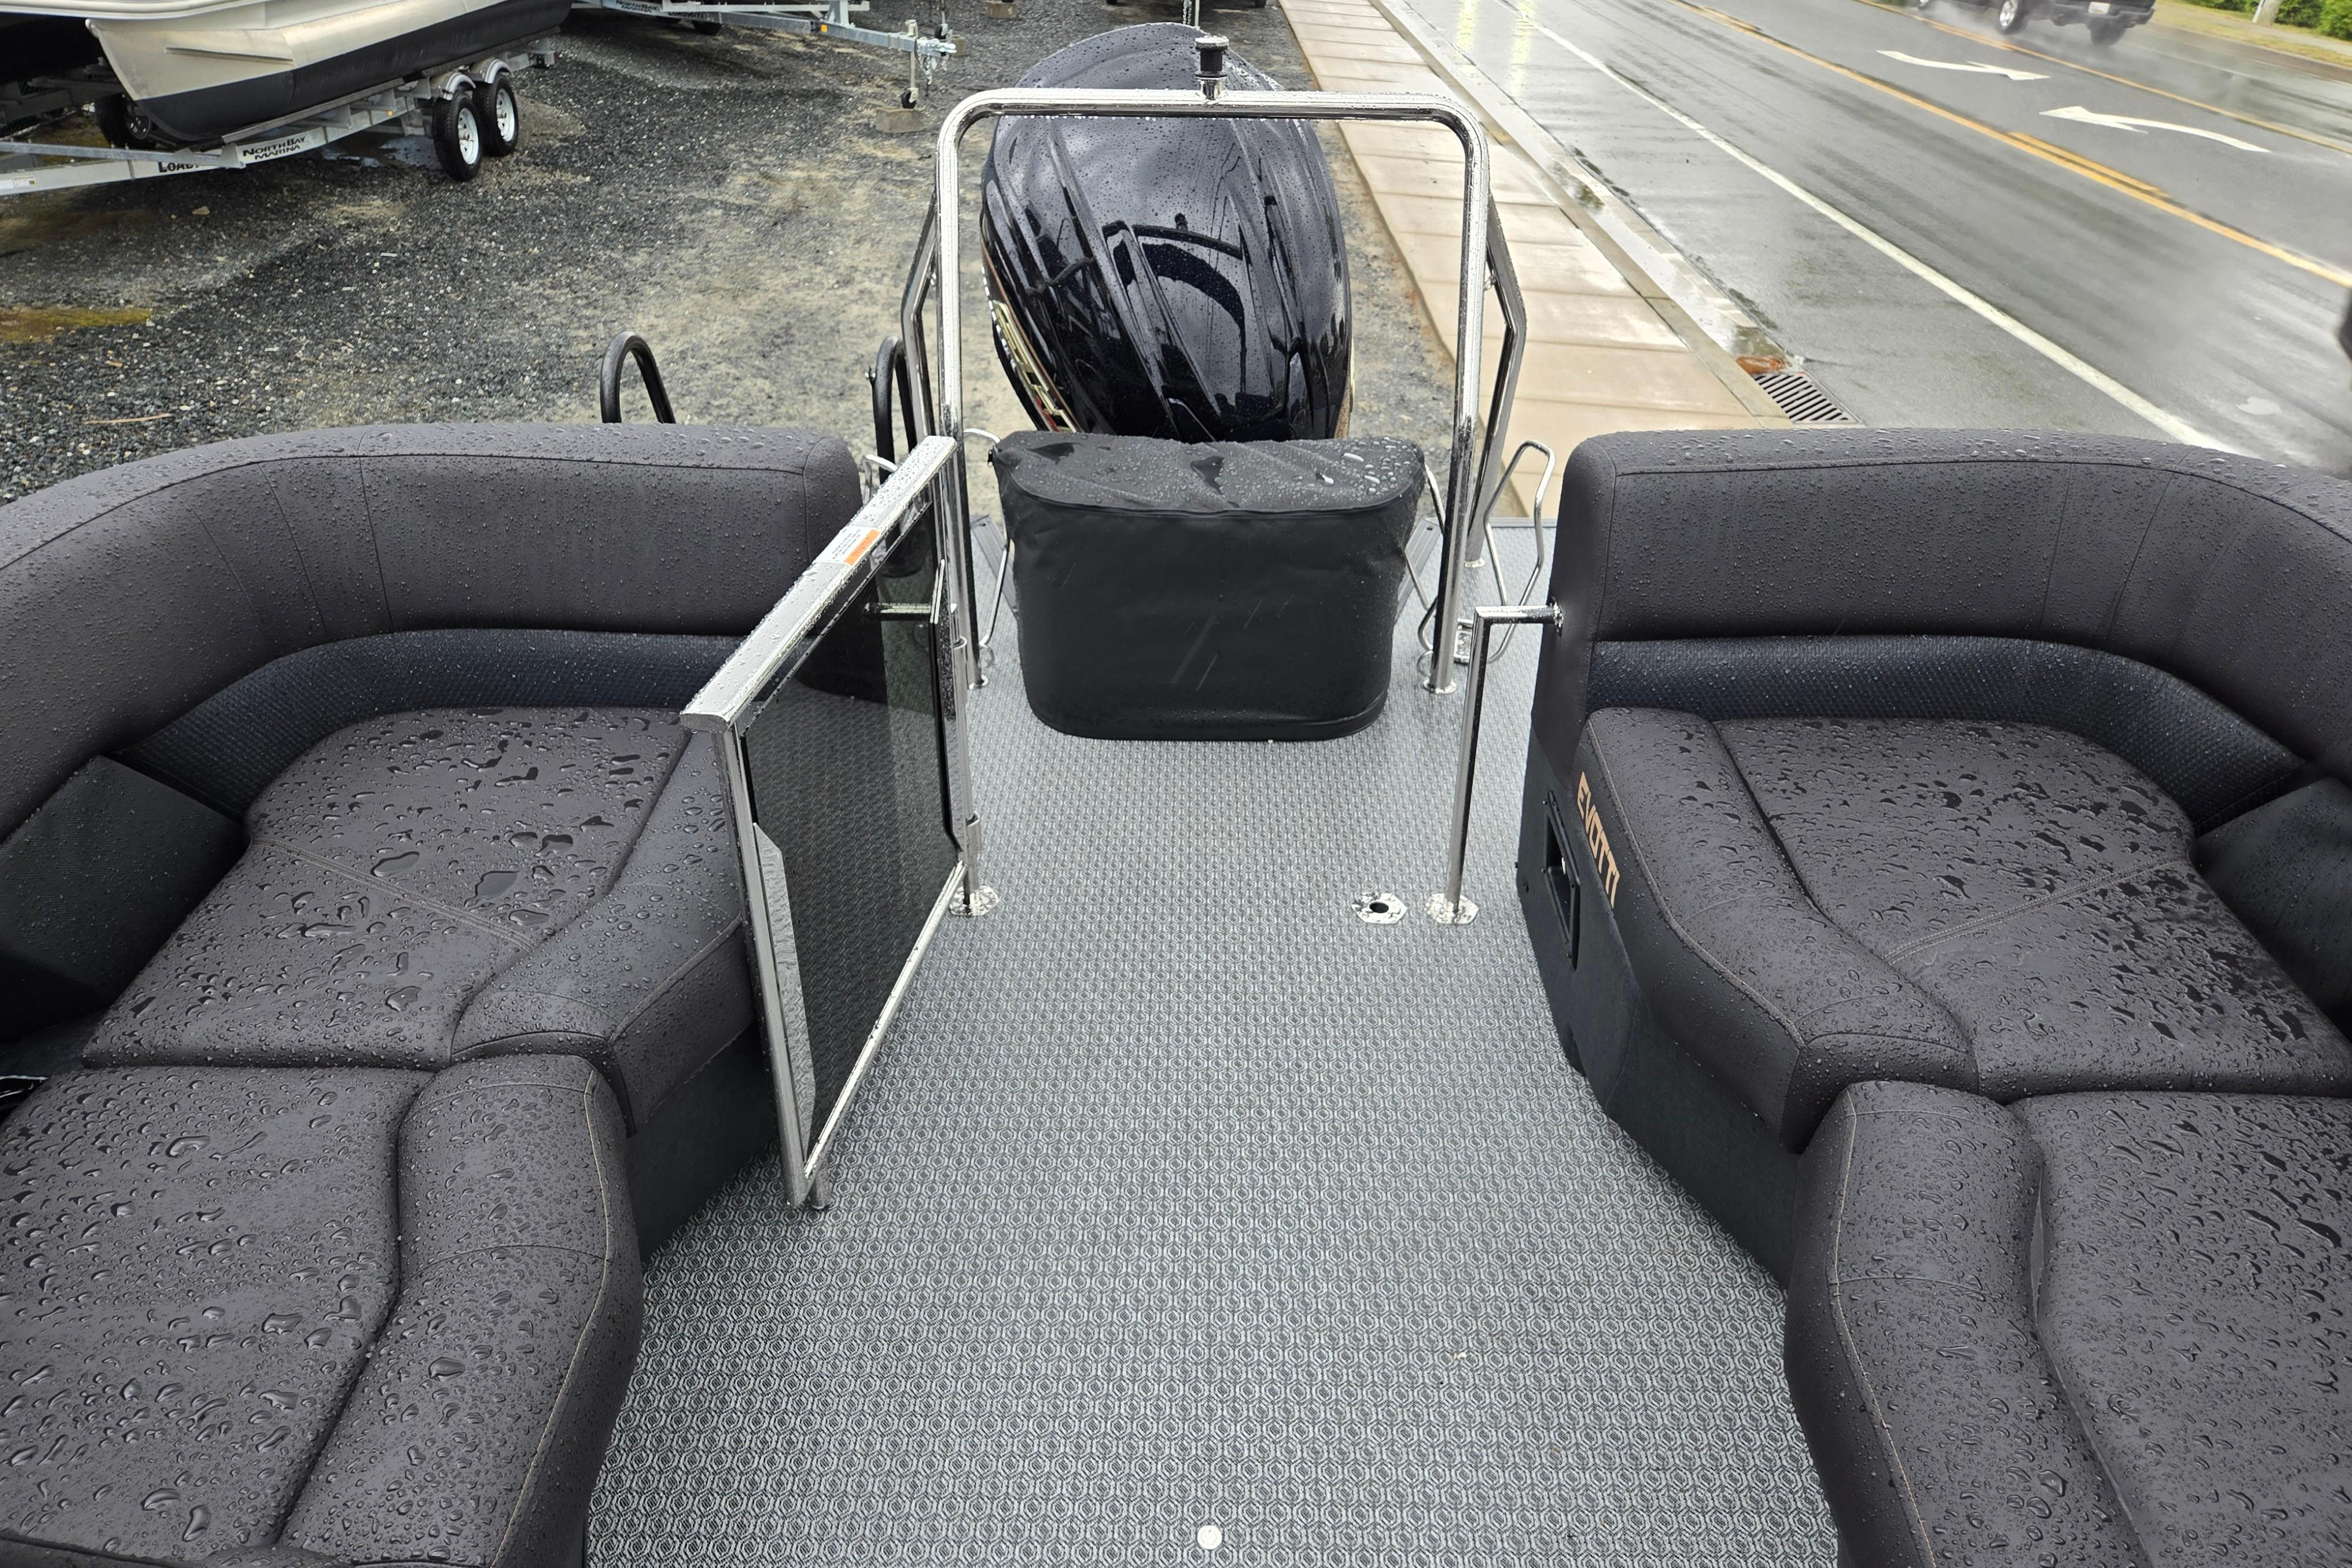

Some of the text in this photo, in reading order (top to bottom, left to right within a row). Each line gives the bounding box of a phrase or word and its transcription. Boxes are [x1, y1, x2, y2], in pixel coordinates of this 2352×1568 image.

[243, 136, 306, 156] NORTH BAY
[255, 145, 300, 160] MARINA
[1577, 771, 1620, 909] EVOTTI
